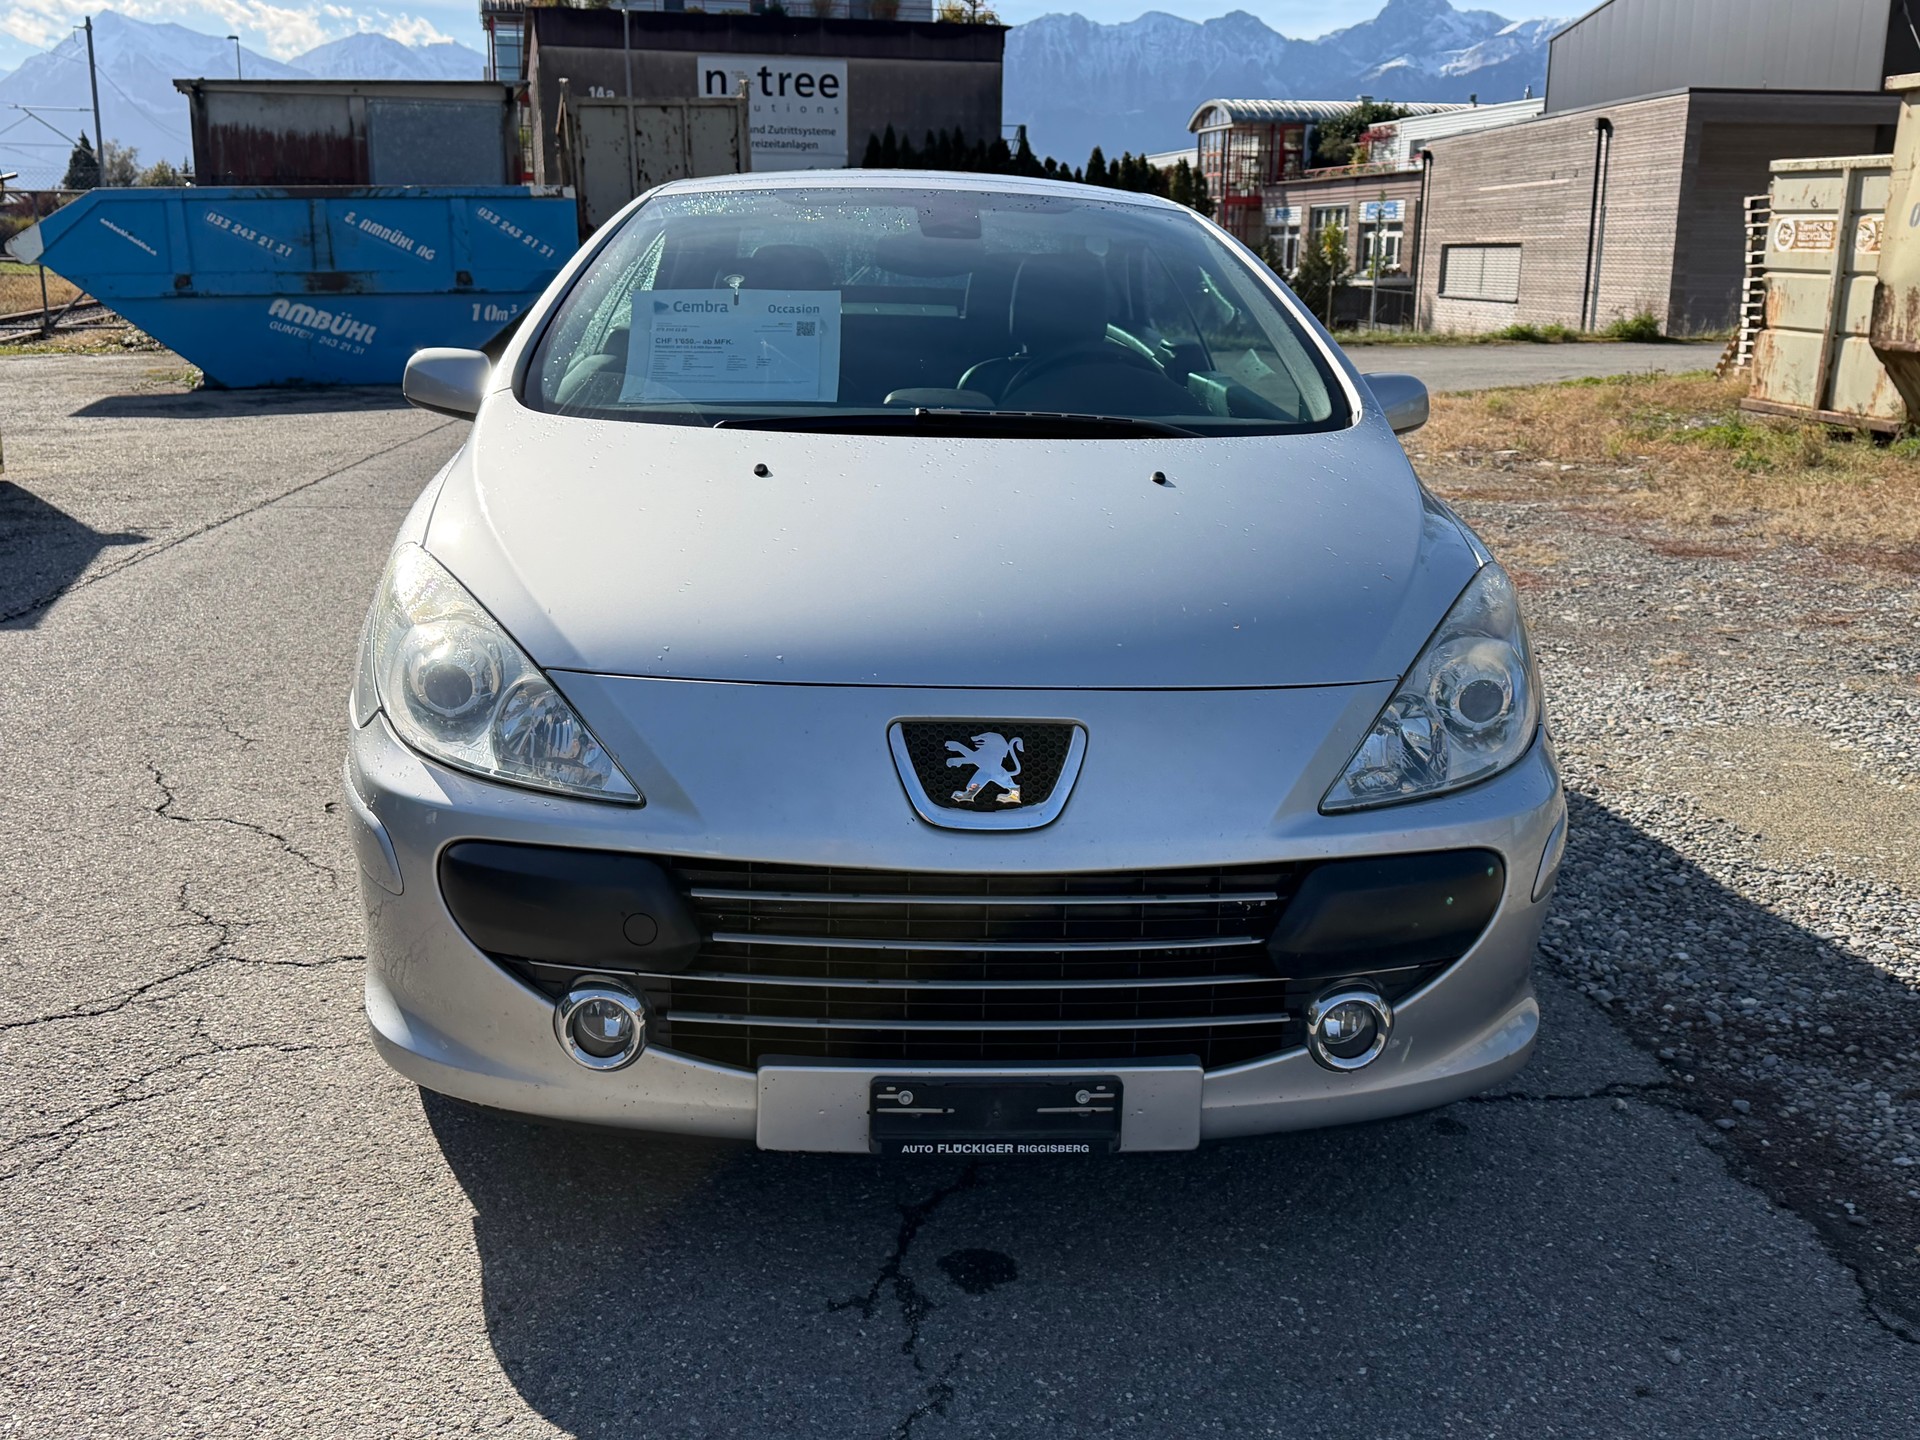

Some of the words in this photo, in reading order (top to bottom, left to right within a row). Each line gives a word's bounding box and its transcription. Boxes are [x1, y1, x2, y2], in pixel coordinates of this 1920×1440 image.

[757, 65, 840, 99] tree
[588, 85, 616, 98] 14a
[753, 104, 839, 115] utions
[768, 125, 837, 138] Zutrittsysteme
[751, 139, 819, 150] reizeitanlagen
[206, 212, 232, 229] 033
[231, 223, 256, 241] 243
[257, 236, 275, 249] 21
[275, 243, 293, 257] 31
[477, 207, 501, 225] 033
[499, 220, 523, 239] 243
[523, 234, 540, 249] 21
[539, 245, 555, 258] 31
[673, 300, 729, 313] Cembra
[768, 304, 820, 314] Occasion
[268, 298, 377, 345] AMBÜHL
[318, 335, 338, 348] 243
[339, 341, 352, 352] 21
[353, 345, 365, 355] 31
[901, 1144, 934, 1154] AUTO
[937, 1143, 1014, 1154] FLÜCKIGER
[1017, 1144, 1089, 1154] RIGGISBERG
